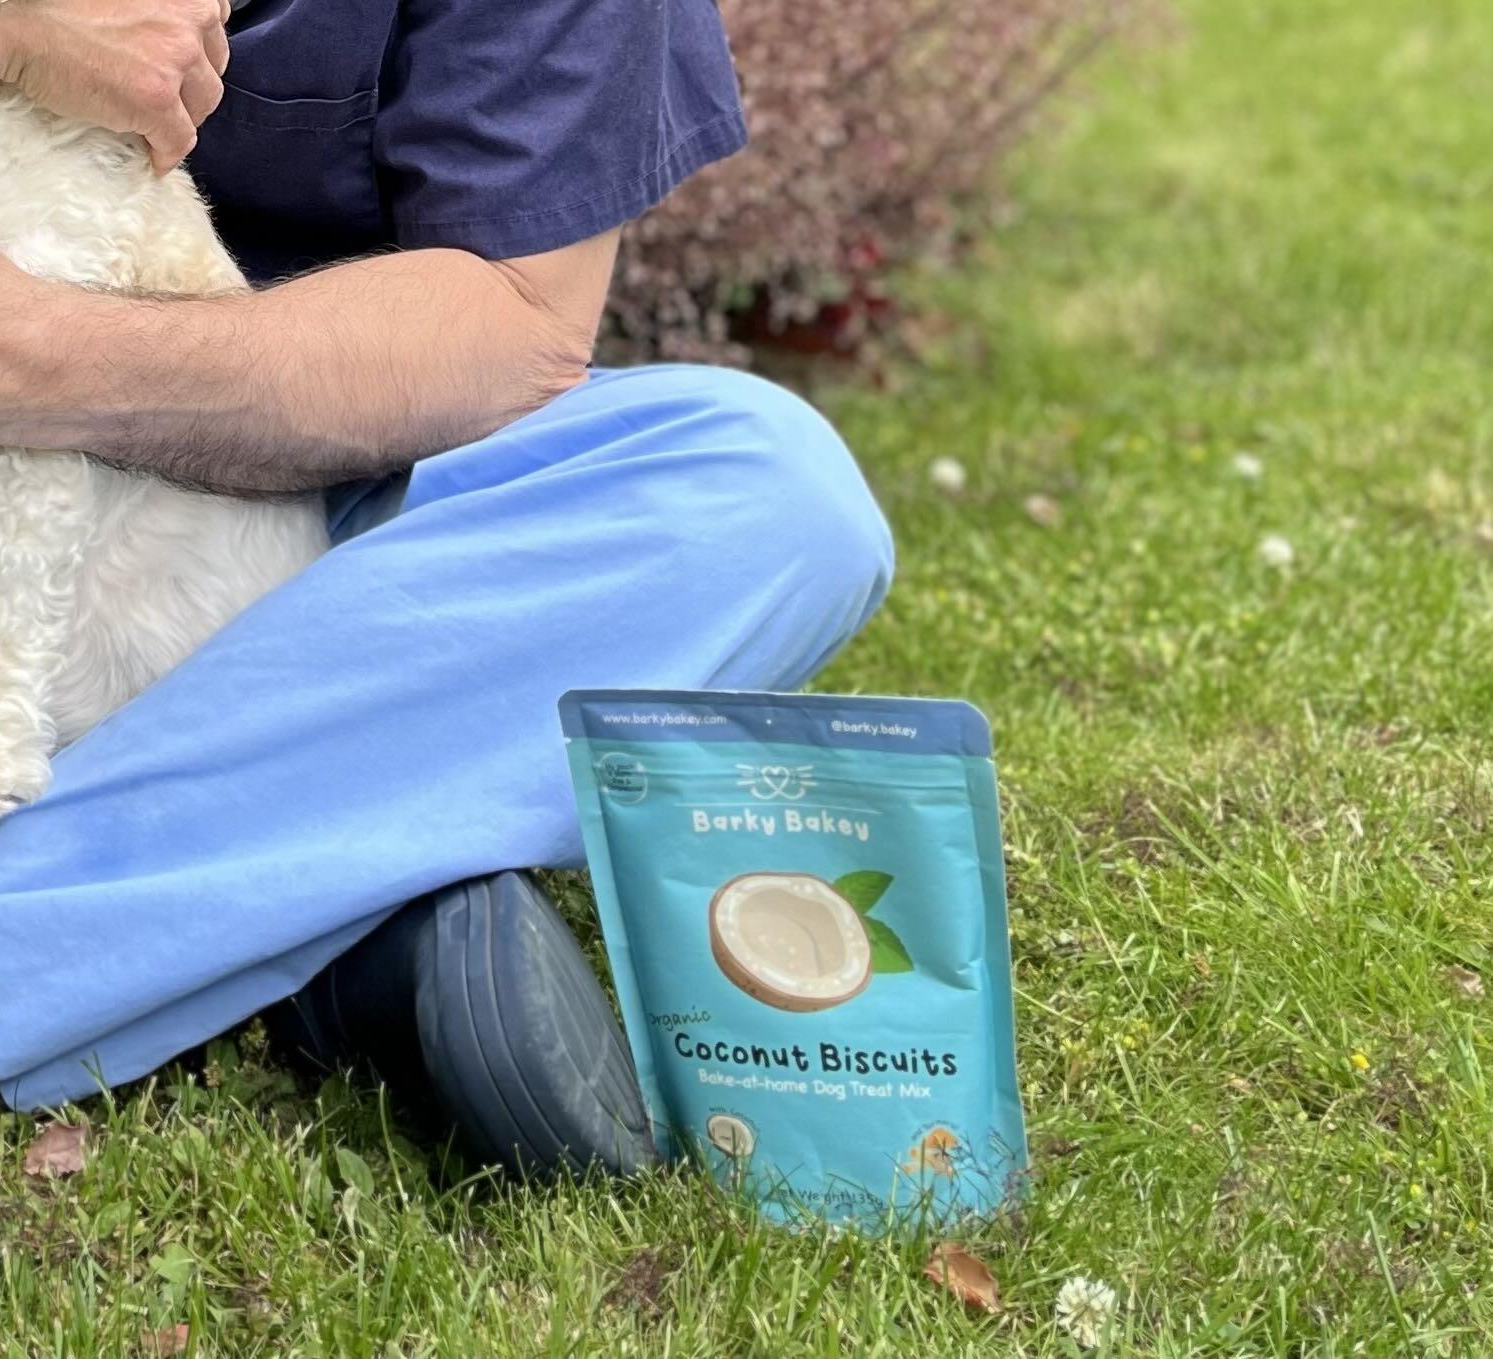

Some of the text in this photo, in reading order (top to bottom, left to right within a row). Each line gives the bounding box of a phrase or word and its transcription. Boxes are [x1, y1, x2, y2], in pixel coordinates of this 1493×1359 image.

[602, 712, 728, 727] www.barkybakey.com
[831, 720, 917, 739] @barky.bakey
[691, 808, 870, 842] Barky Bakey
[674, 1032, 958, 1077] Coconut Biscuits
[698, 1068, 932, 1100] Bake-at-home Dog Treat Mix
